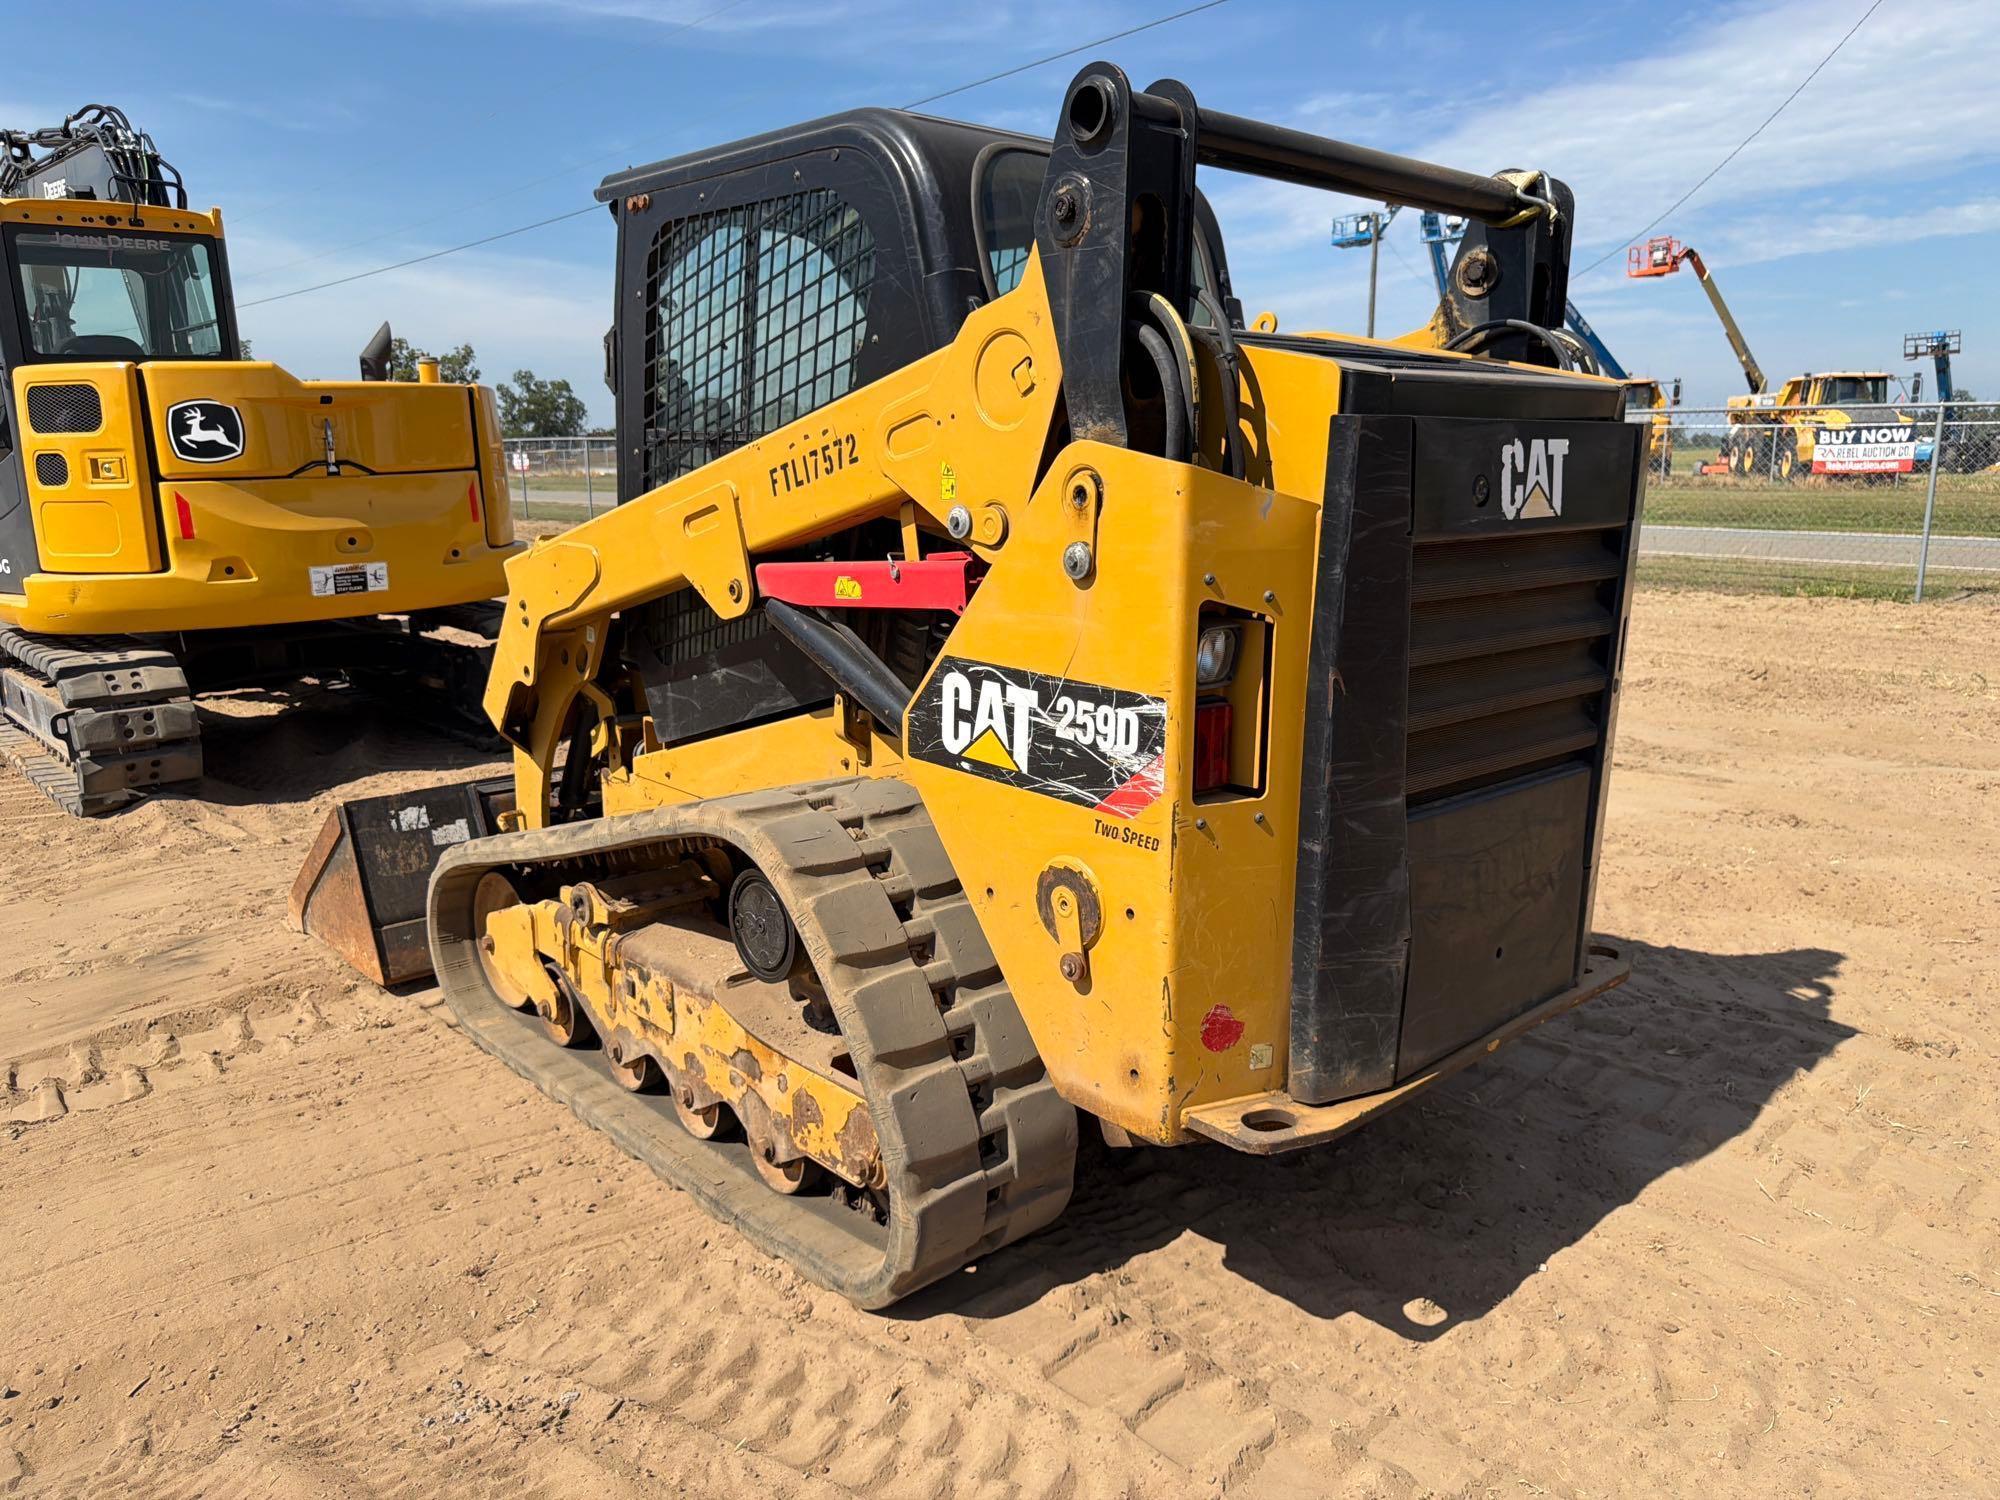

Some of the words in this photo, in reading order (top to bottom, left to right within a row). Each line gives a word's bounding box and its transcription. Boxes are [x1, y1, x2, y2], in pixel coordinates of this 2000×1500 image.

[43, 178, 67, 200] DEERE
[51, 231, 103, 249] JOHN
[107, 234, 171, 251] DEERE
[1819, 430, 1857, 445] BUY
[1861, 428, 1911, 443] NOW
[1836, 447, 1859, 459] REBEL
[1862, 446, 1897, 458] AUCTION
[1501, 437, 1569, 520] CAT
[941, 671, 1038, 774] CAT
[1055, 696, 1139, 756] 259D
